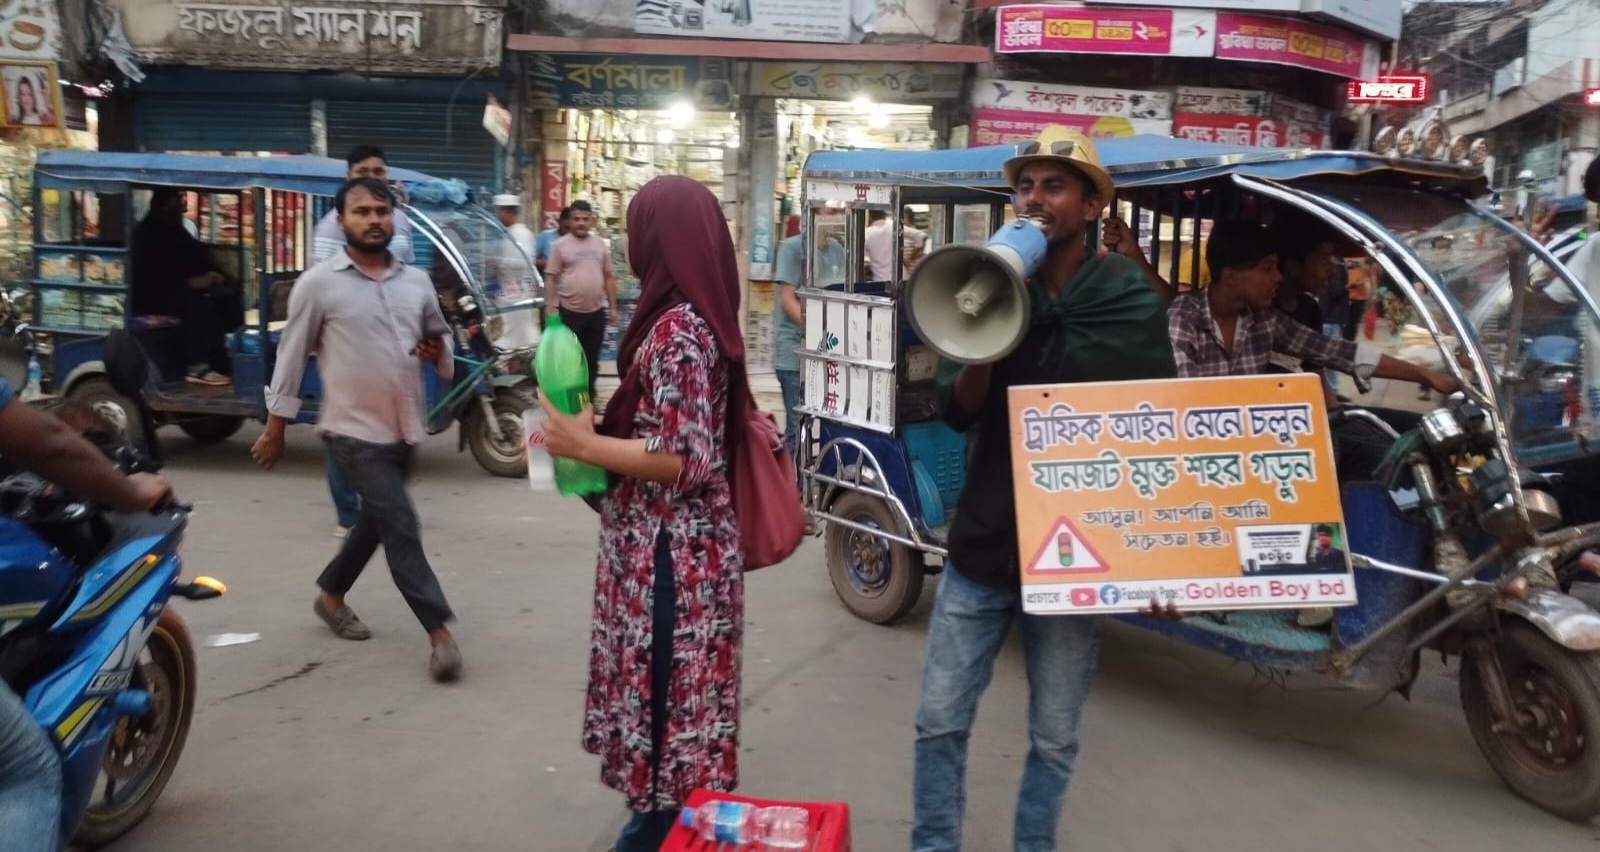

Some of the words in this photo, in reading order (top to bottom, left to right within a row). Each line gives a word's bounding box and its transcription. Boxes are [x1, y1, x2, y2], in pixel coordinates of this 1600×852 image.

[178, 5, 288, 48] ফজলু
[564, 57, 686, 90] বর্ণমালা
[1024, 403, 1102, 450] ট্রাফিক
[1107, 403, 1176, 442] আইন
[1184, 408, 1242, 438] মেনে
[1248, 404, 1312, 444] চলুন
[1031, 450, 1120, 491] যানজট
[1127, 456, 1177, 497] মুক্ত
[1183, 453, 1243, 486] শহর
[1250, 450, 1315, 499] গড়ুন
[1151, 501, 1214, 522] আপনি
[1221, 500, 1270, 520] আমি
[1123, 531, 1188, 550] সচেতন
[1185, 582, 1262, 600] Golden
[1268, 580, 1311, 601] Boy
[1317, 578, 1347, 596] bd
